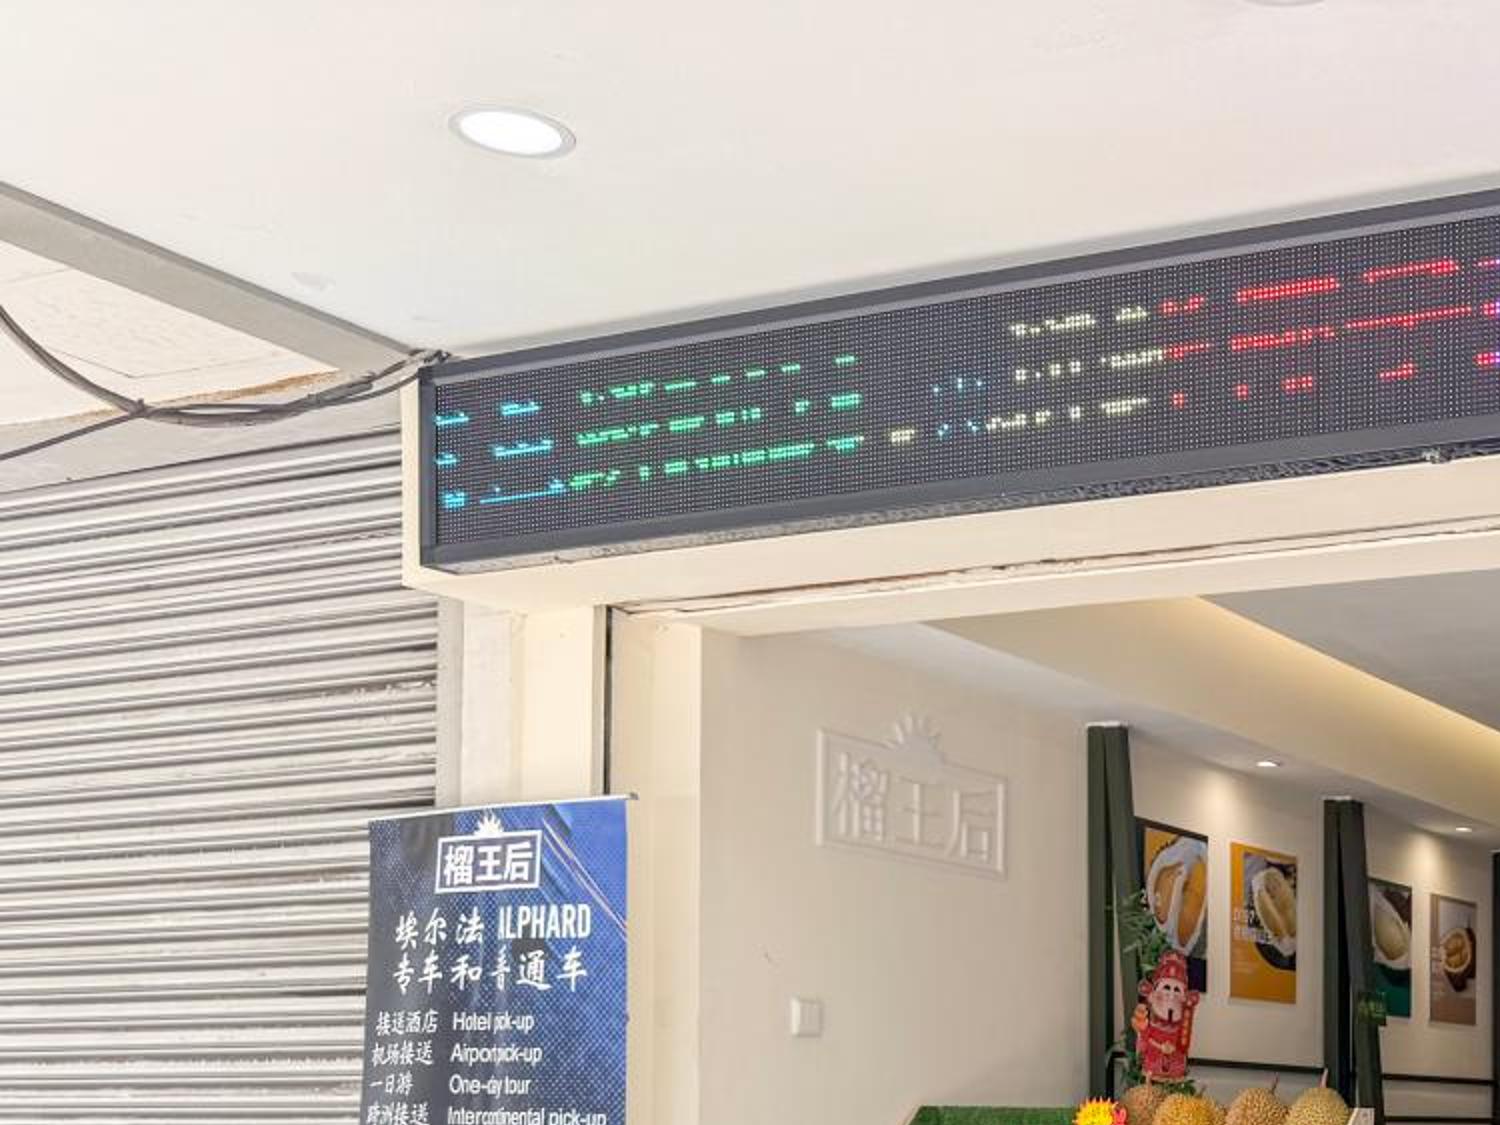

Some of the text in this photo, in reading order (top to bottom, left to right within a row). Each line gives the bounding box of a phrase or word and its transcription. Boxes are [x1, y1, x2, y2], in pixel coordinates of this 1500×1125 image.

[443, 843, 534, 885] 榴王后
[394, 906, 485, 950] 埃尔法
[453, 1011, 490, 1031] Hotel
[505, 1076, 531, 1096] tour
